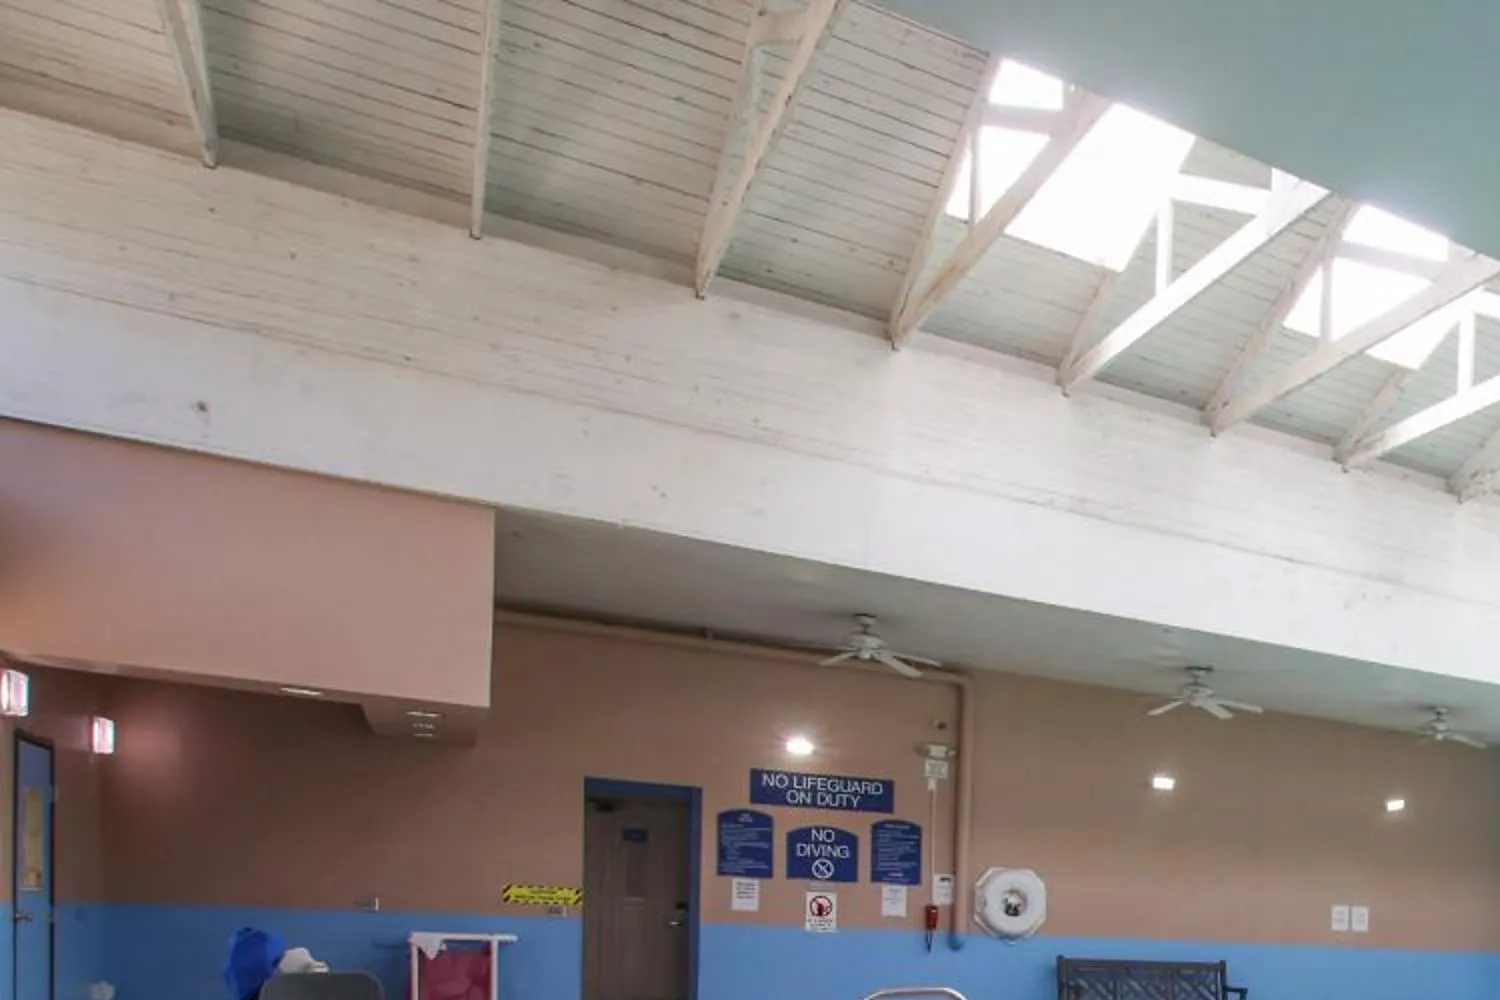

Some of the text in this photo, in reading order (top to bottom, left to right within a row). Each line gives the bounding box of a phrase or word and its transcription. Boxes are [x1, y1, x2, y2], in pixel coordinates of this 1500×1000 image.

[762, 773, 883, 795] NO LIFEGUARD
[786, 790, 862, 808] ON DUTY
[811, 827, 835, 842] NO
[796, 843, 849, 858] DIVING
